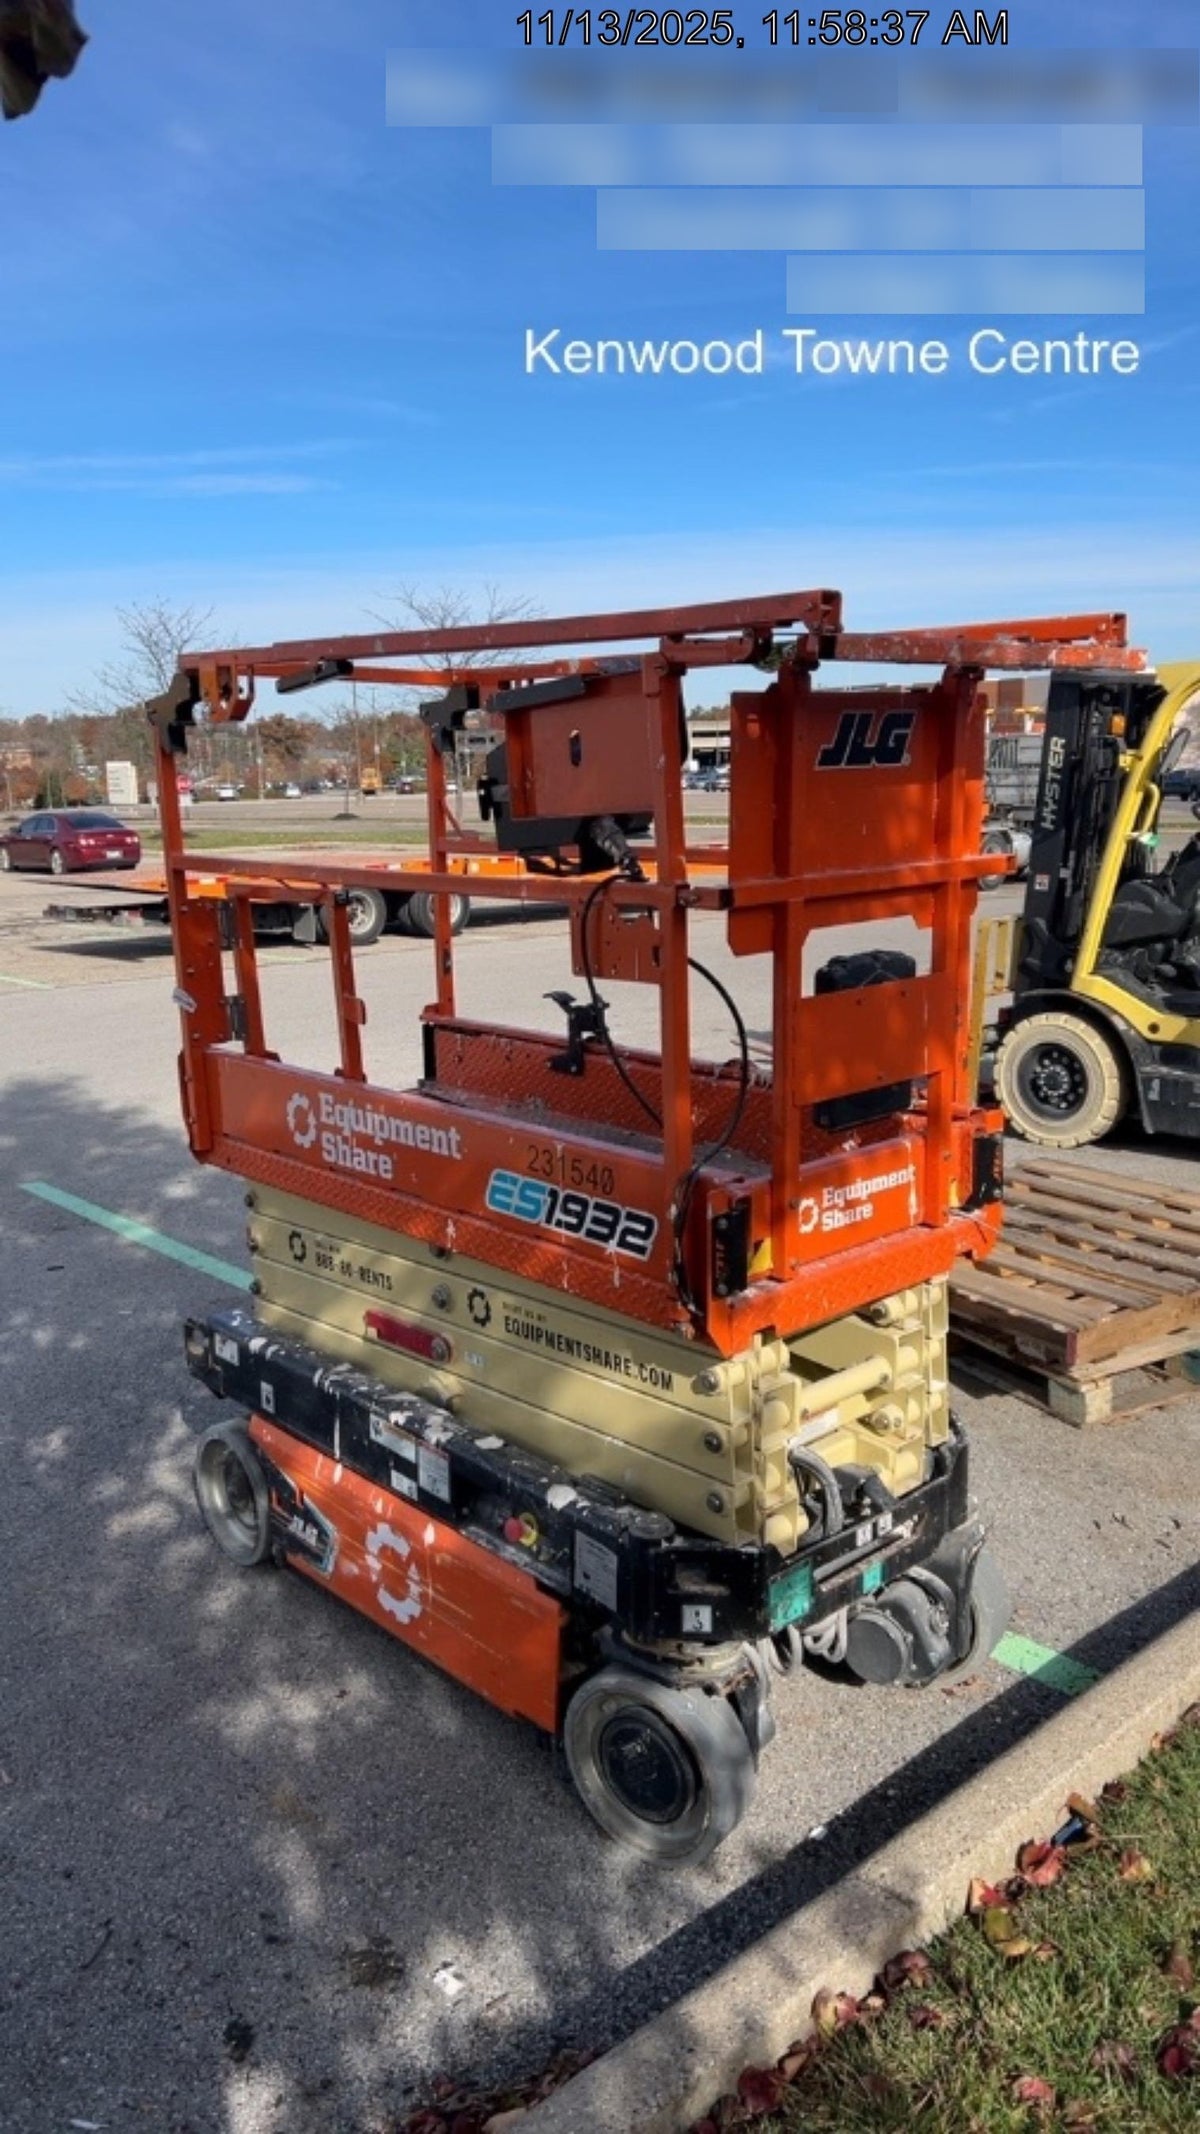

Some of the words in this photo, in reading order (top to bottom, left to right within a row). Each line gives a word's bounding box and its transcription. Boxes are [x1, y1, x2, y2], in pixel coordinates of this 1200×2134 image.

[814, 709, 917, 771] JLG
[1040, 736, 1066, 831] HYSTER
[318, 1092, 462, 1160] Equipment
[321, 1131, 393, 1180] Share
[486, 1168, 659, 1262] ES1932
[821, 1163, 916, 1208] Equipment
[821, 1202, 874, 1233] Share
[504, 1315, 674, 1392] EQUIPMENTSHARE.COM
